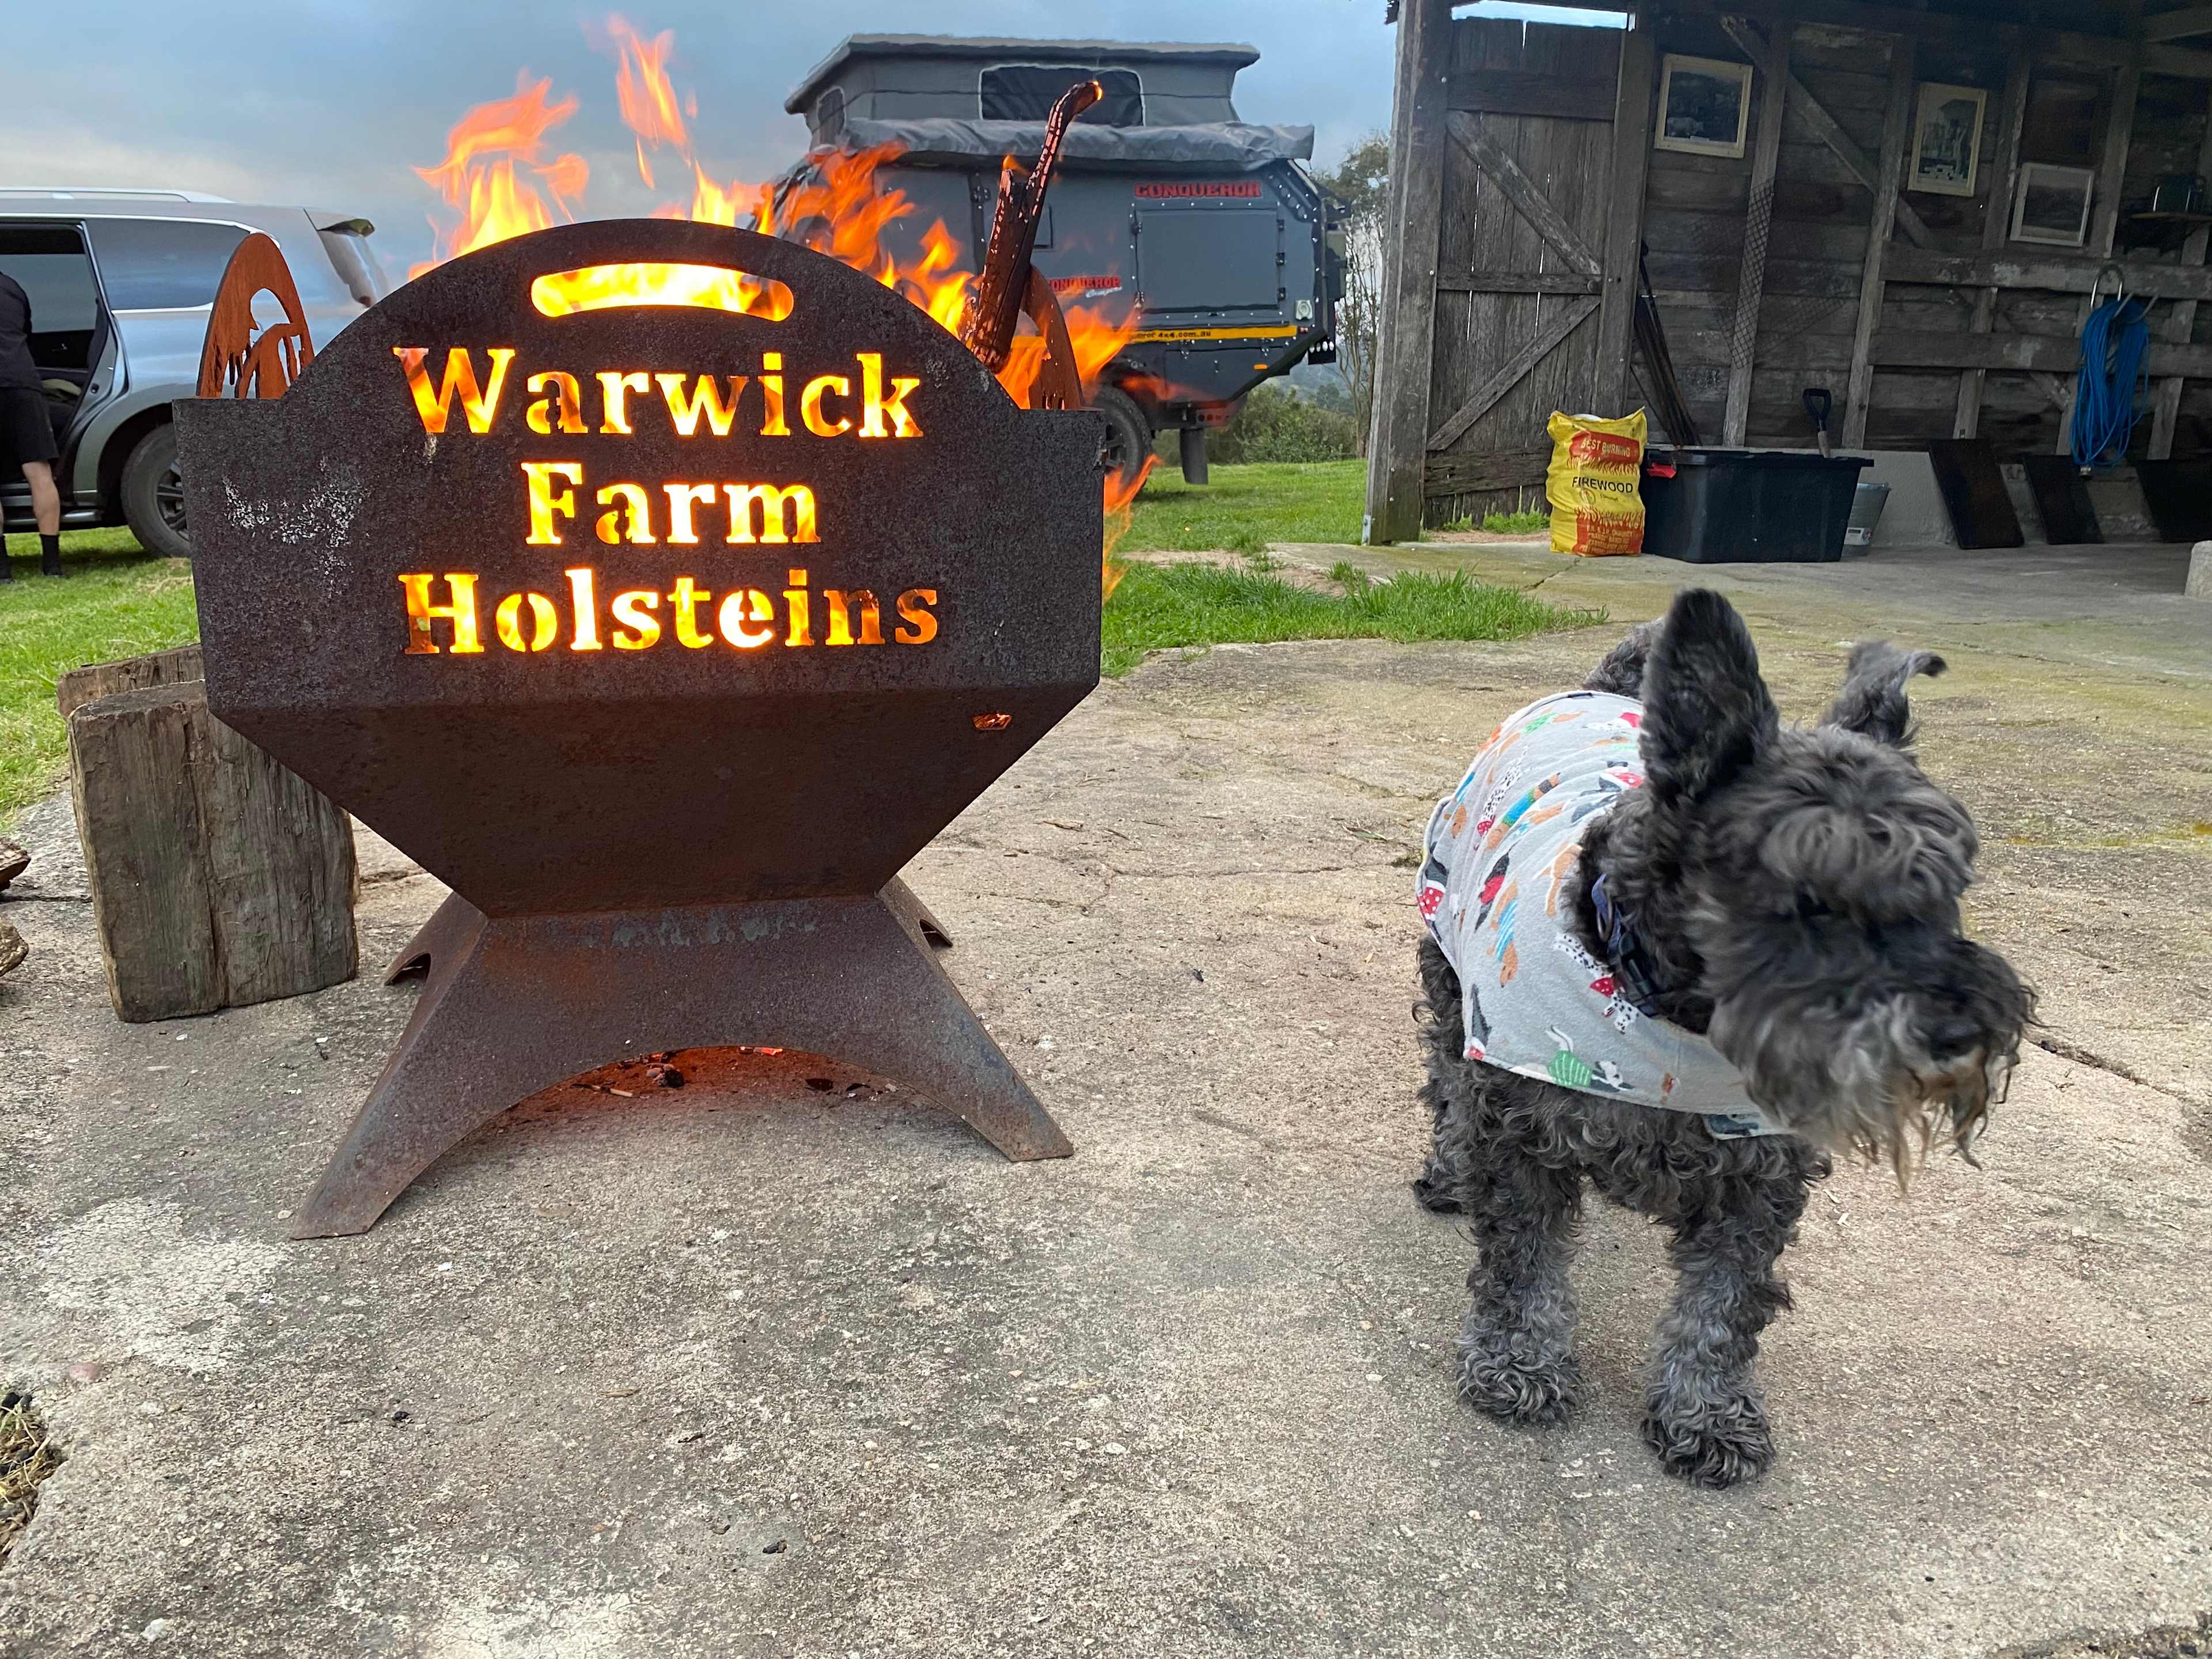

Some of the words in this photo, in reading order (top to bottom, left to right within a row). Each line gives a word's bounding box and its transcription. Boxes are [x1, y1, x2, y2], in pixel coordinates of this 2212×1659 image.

[1134, 182, 1262, 198] CONQUEROR
[393, 347, 924, 438] Warwick
[1580, 438, 1601, 451] BEST
[1601, 442, 1631, 457] BURNING
[521, 462, 821, 545] Farm
[1572, 476, 1634, 494] FIREWOOD
[398, 568, 938, 654] Holsteins
